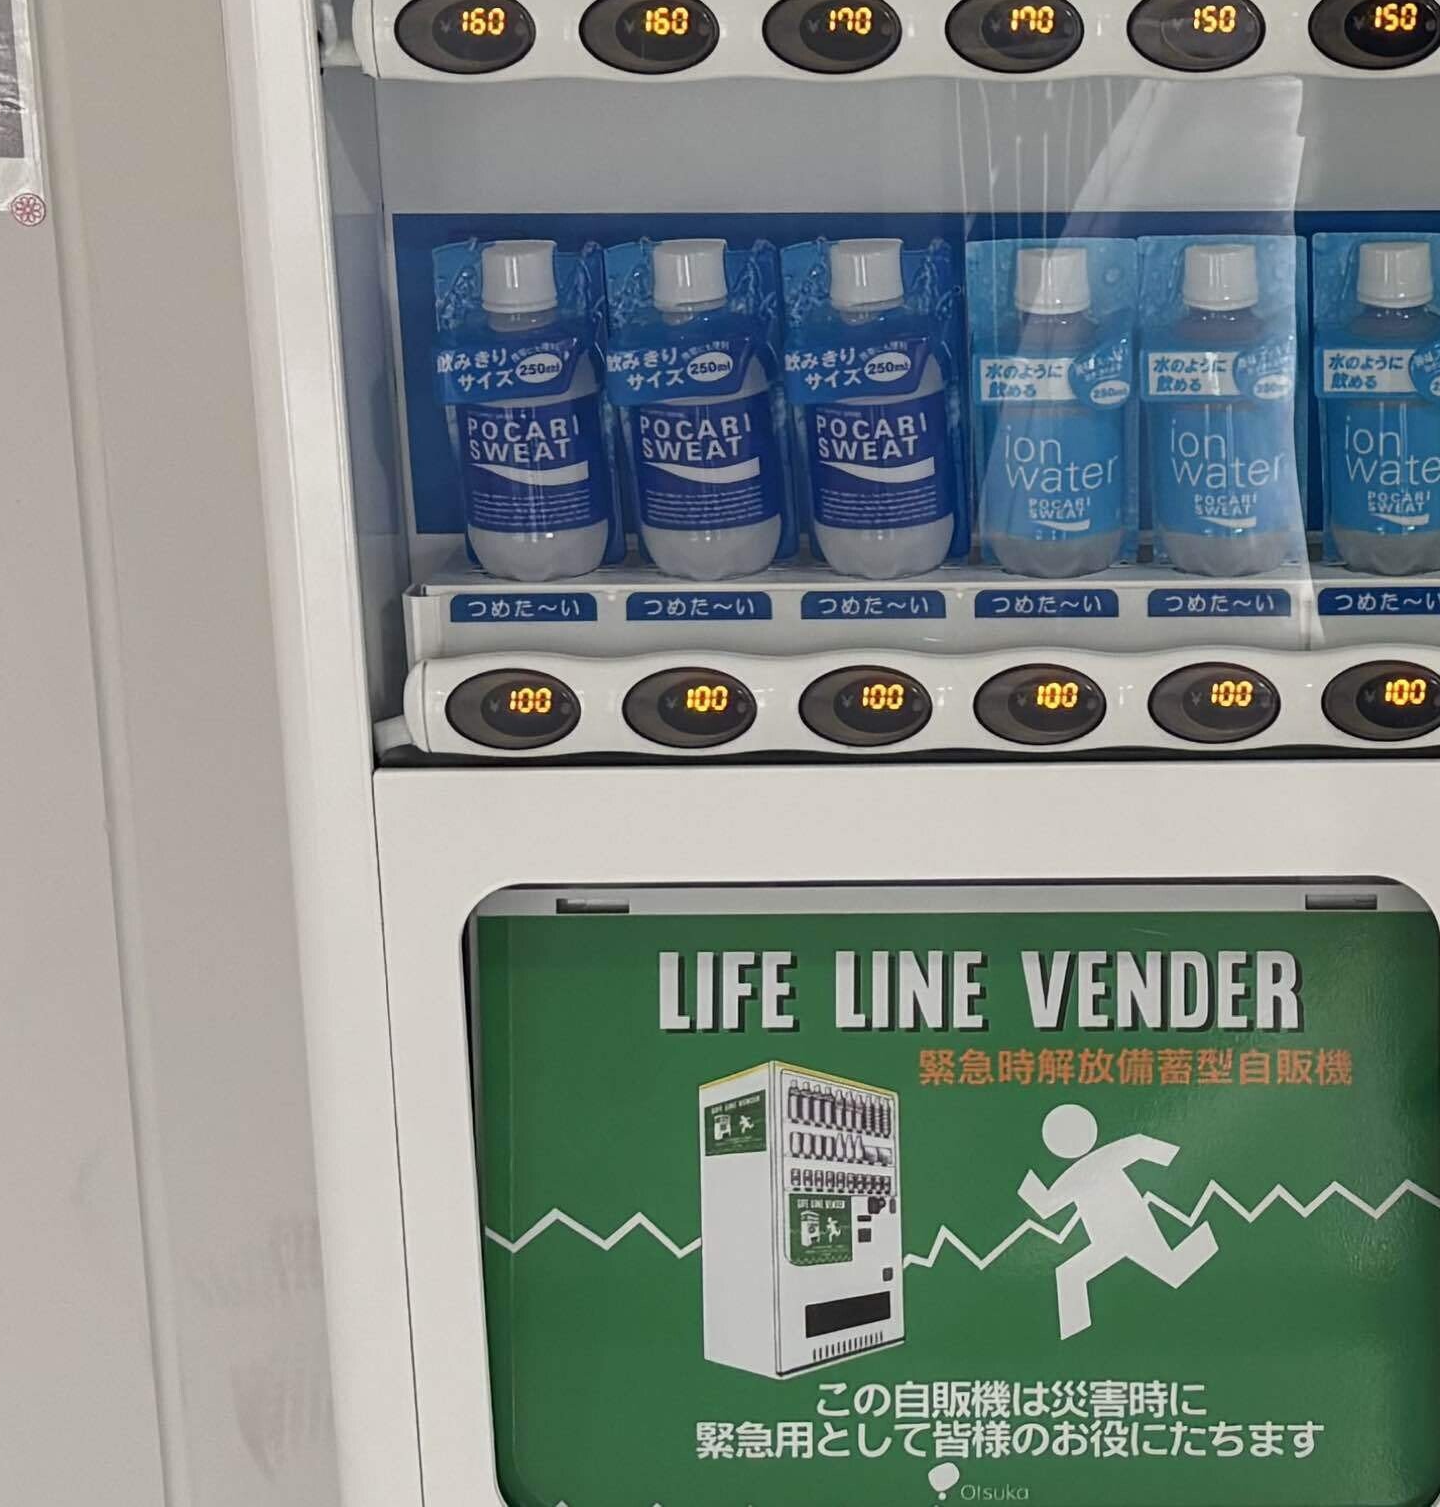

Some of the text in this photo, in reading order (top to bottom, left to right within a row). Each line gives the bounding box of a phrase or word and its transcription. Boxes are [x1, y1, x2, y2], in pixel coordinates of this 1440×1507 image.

[463, 8, 504, 35] 160
[646, 8, 688, 34] 160
[830, 7, 871, 34] 170
[1011, 6, 1053, 33] 170
[1195, 6, 1236, 32] 150
[1375, 4, 1417, 31] 150
[468, 418, 580, 440] POCARI
[1344, 418, 1402, 457] ion
[469, 439, 571, 464] SWEAT
[510, 688, 551, 713] 100
[687, 686, 727, 711] 100
[863, 684, 903, 709] 100
[1037, 683, 1078, 708] 100
[1212, 681, 1252, 706] 100
[1385, 679, 1426, 705] 100
[658, 950, 1306, 1033] LIFE LINE VENDER
[918, 1049, 1353, 1087] 緊急時解放備蓄型自販機
[816, 1380, 1206, 1420] この自販機は災害時に
[695, 1420, 1326, 1460] 緊急用として皆様のお役にたちます
